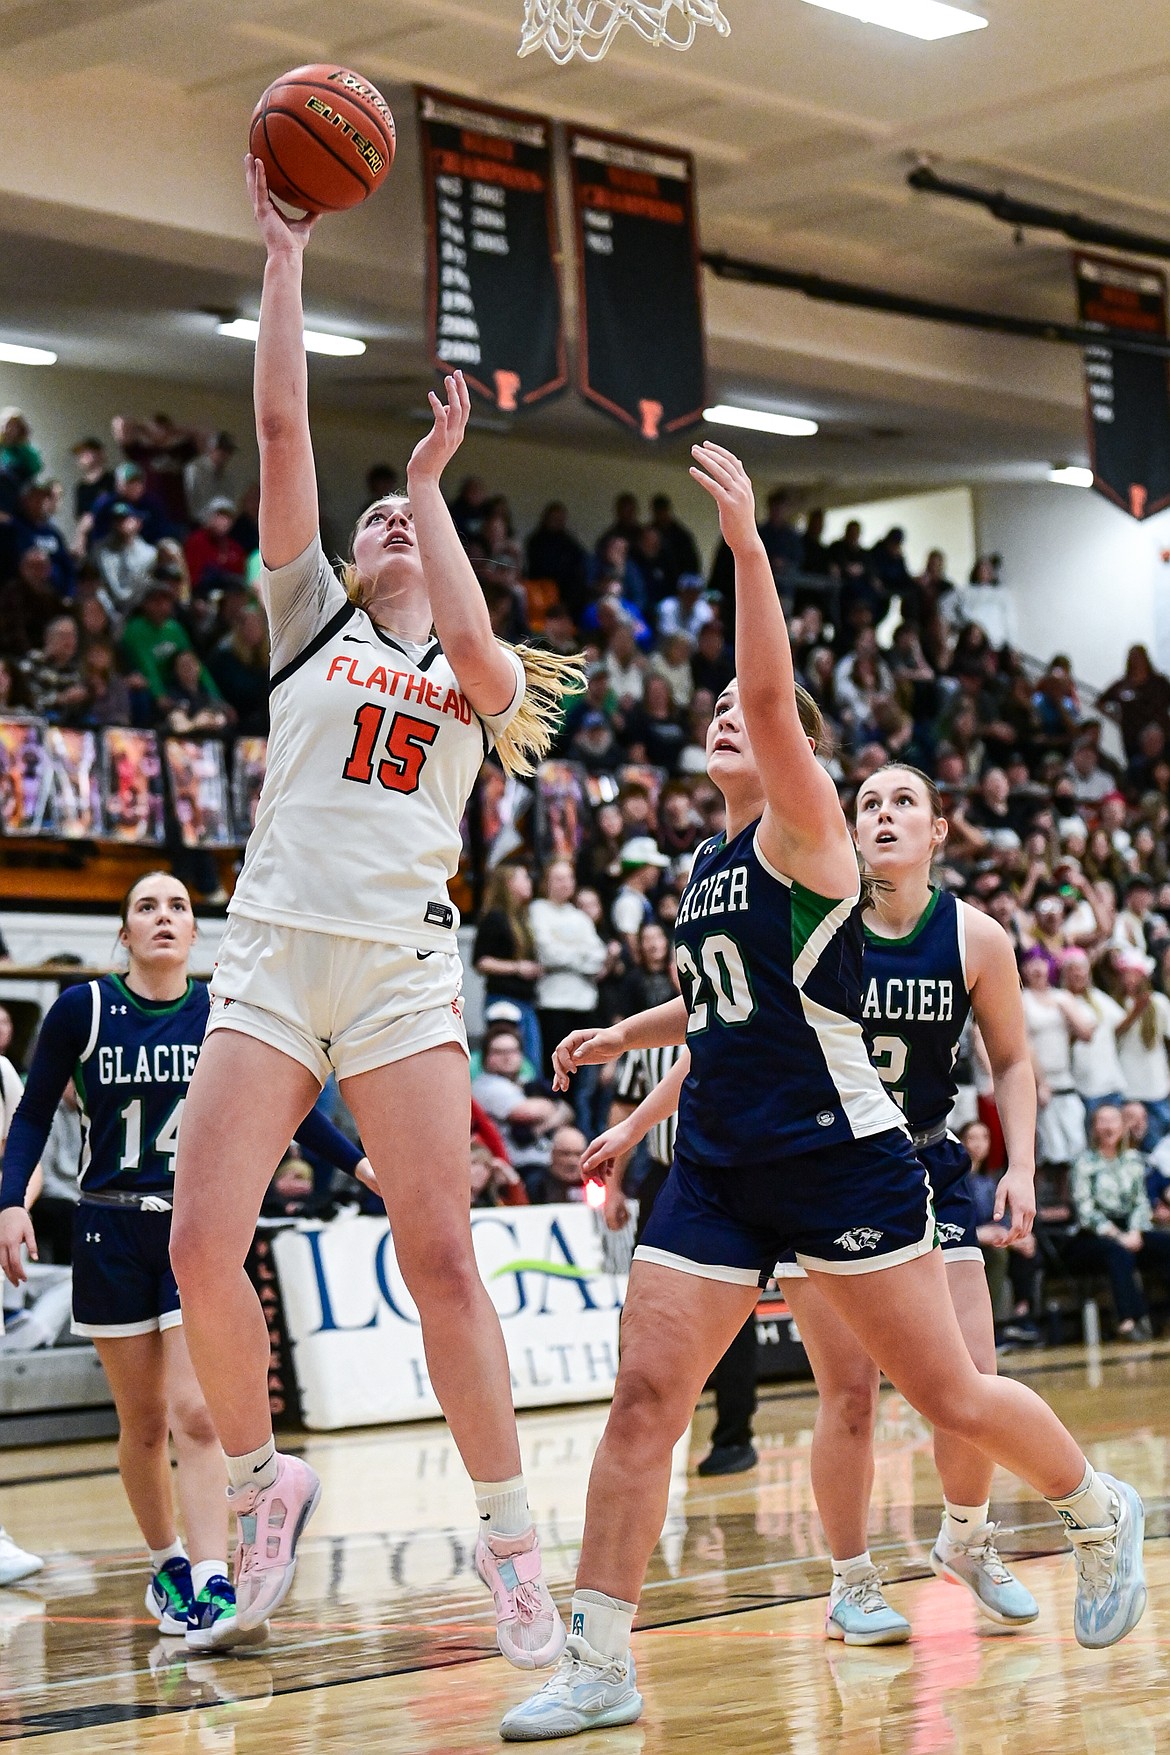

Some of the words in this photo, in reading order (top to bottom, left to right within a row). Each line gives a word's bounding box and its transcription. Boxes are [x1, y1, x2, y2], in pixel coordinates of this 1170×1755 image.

[305, 96, 369, 153] ELITE
[361, 144, 385, 176] PRO
[326, 655, 473, 726] FLATHEAD
[341, 701, 441, 796] 15
[674, 865, 749, 929] ACIER
[675, 931, 756, 1035] 20
[861, 977, 953, 1021] ACIER
[98, 1044, 202, 1084] GLACIE
[870, 1034, 909, 1110] 2
[119, 1098, 186, 1171] 14
[306, 1216, 626, 1332] LOGA
